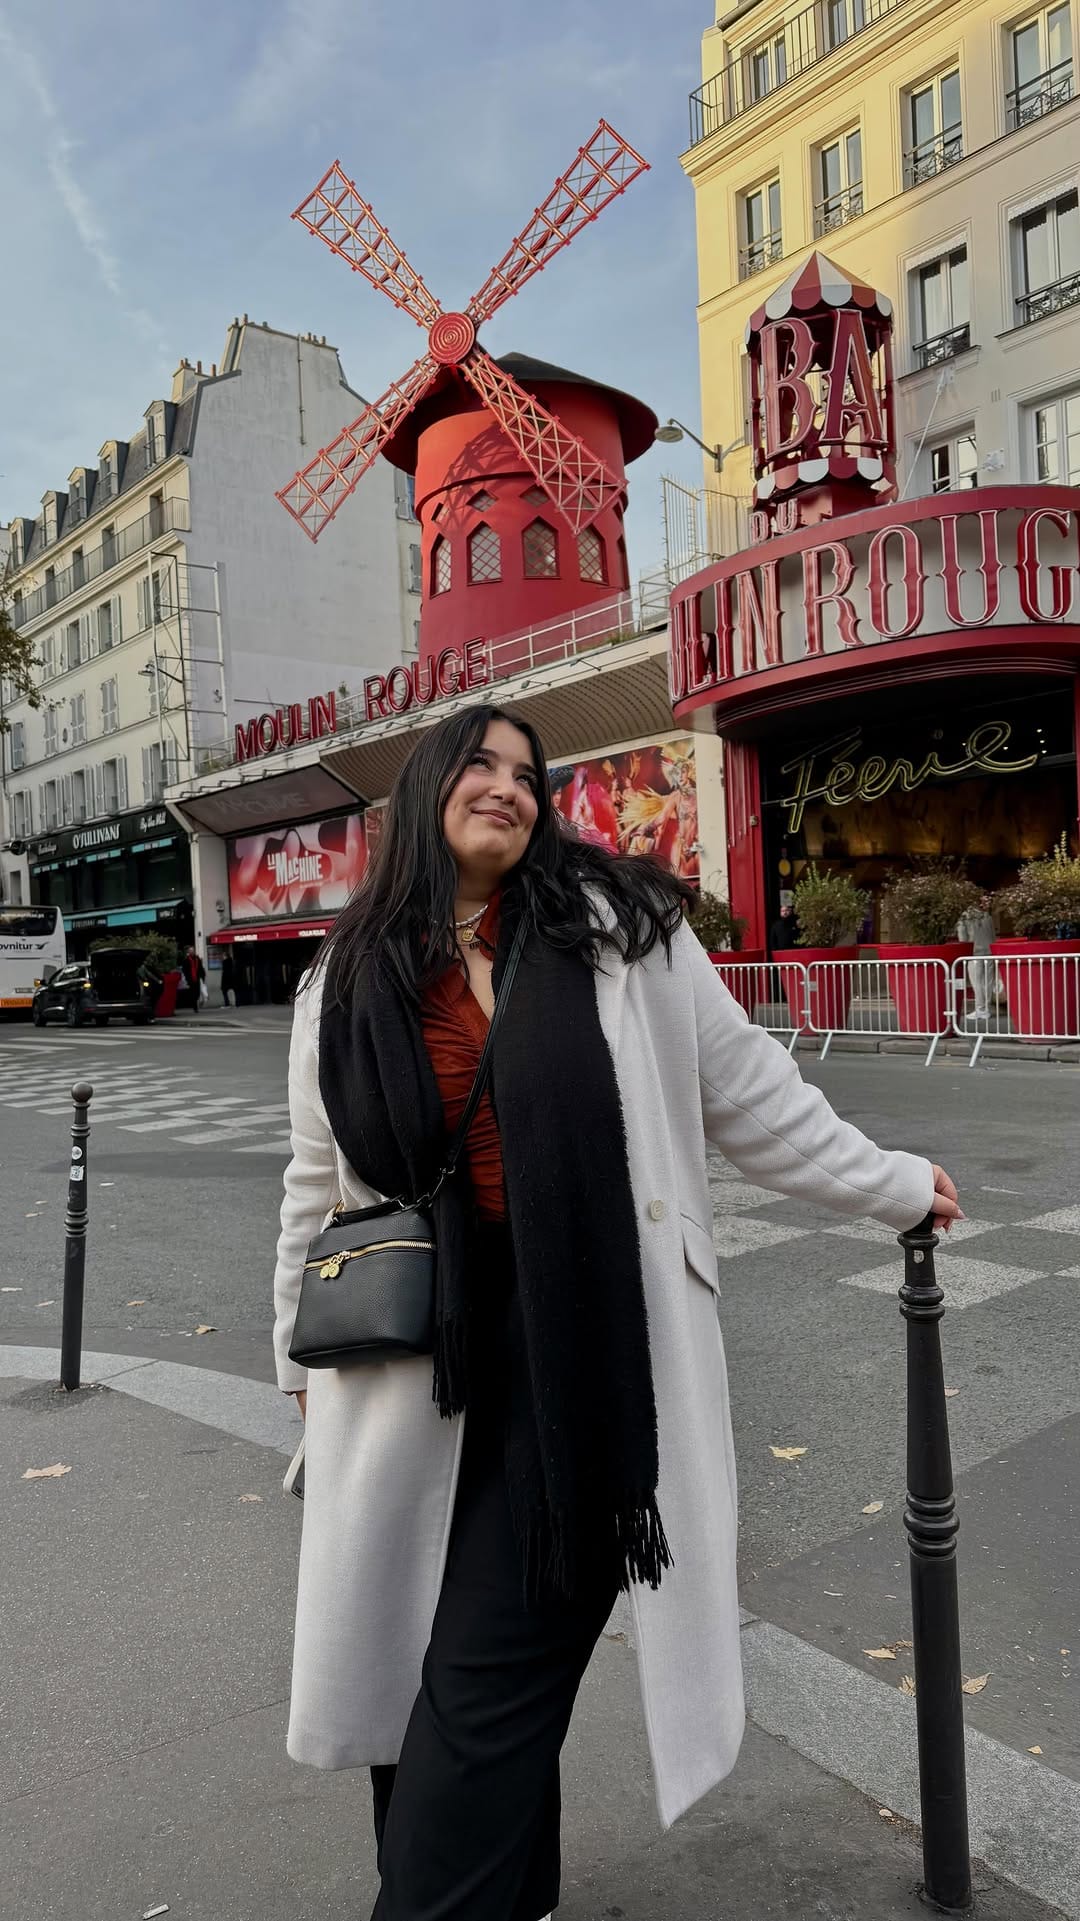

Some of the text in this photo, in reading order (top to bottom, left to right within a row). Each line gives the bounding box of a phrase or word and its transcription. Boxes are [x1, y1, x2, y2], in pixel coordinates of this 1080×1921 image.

[749, 498, 798, 543] DU
[668, 508, 1080, 703] ULIN ROUG
[234, 636, 489, 762] MOULIN ROUGE
[73, 824, 120, 849] O'SULLIVANS
